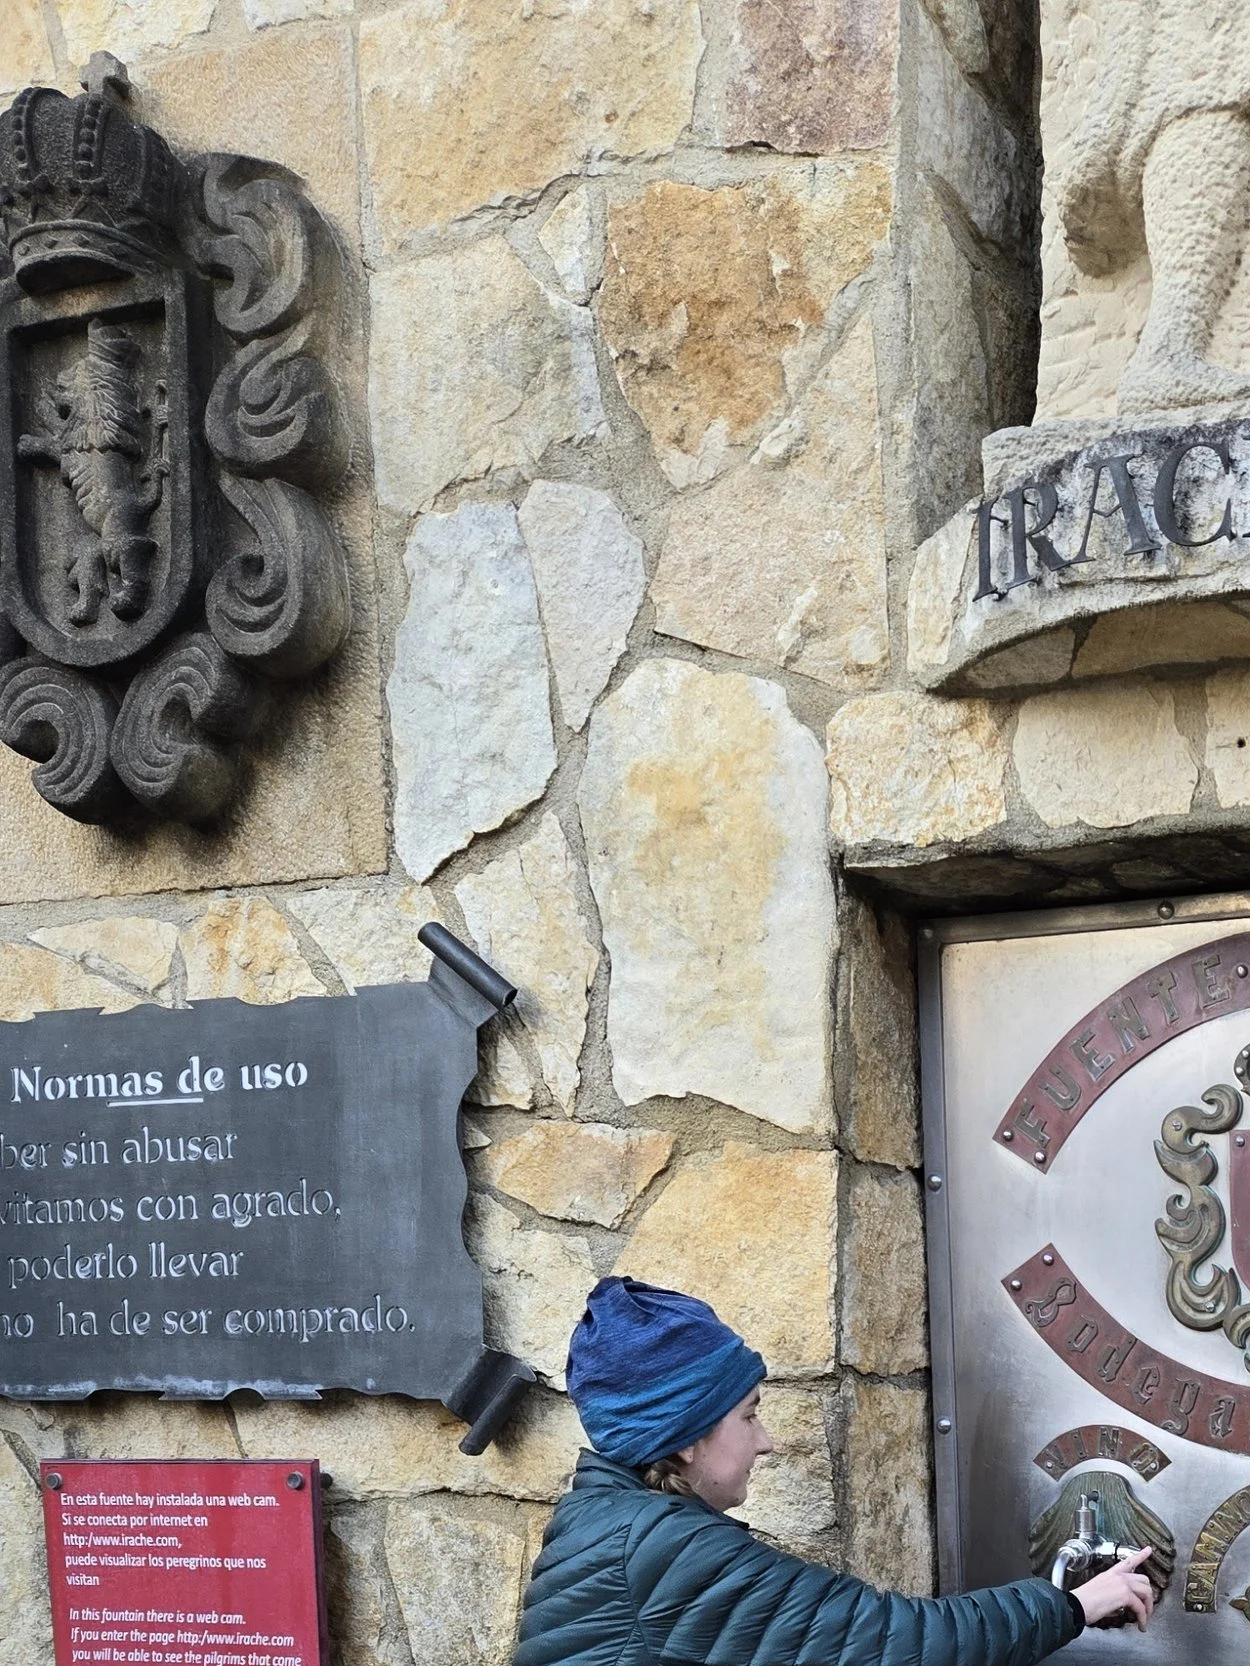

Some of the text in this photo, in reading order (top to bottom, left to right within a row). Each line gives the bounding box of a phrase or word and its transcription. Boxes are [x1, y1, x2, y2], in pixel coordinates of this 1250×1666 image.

[1011, 953, 1231, 1148] FUENTE
[10, 1056, 309, 1104] Normas de uso
[62, 1130, 110, 1168] sin
[122, 1126, 238, 1166] abusar
[136, 1192, 199, 1223] con
[211, 1178, 342, 1229] agrado,
[8, 1242, 244, 1289] poderlo llevar
[57, 1300, 99, 1337] ha
[108, 1298, 150, 1336] de
[162, 1306, 213, 1336] ser
[224, 1294, 416, 1344] comprado.
[1044, 1426, 1159, 1474] VINO
[60, 1492, 280, 1509] En esta fuente hay instalada una web cam.
[61, 1512, 209, 1529] Si se conecta por internet en
[65, 1553, 267, 1571] puede visualizar los peregrinos que nos
[66, 1573, 100, 1586] visitan
[69, 1608, 246, 1625] In this fountain there is a web cam.
[71, 1627, 80, 1643] If
[80, 1630, 99, 1643] you
[101, 1630, 128, 1642] enter
[130, 1629, 147, 1642] the
[148, 1632, 175, 1646] page
[72, 1648, 302, 1666] you will be able to see the pilgrims that come
